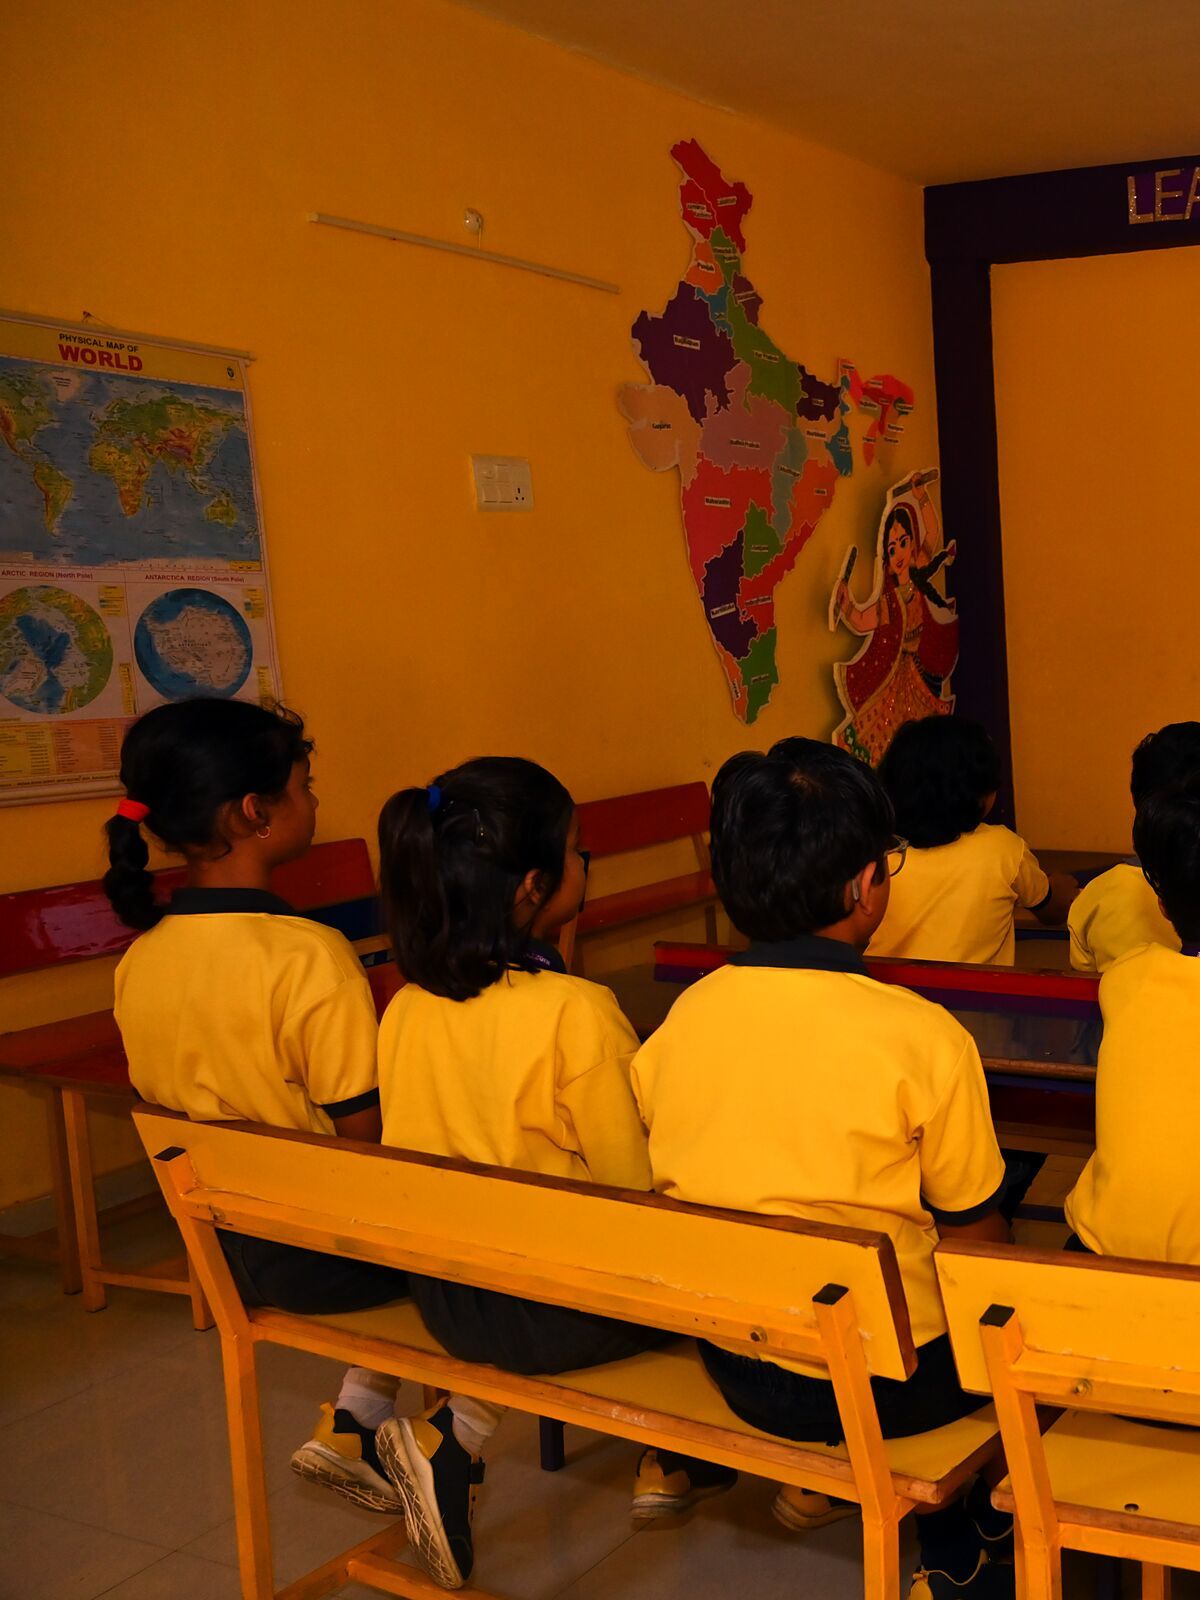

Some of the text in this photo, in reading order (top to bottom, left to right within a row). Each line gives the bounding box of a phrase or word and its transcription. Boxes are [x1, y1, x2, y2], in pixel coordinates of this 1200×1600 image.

[59, 333, 139, 353] PHYSICAL MAP OF
[58, 343, 143, 371] WORLD
